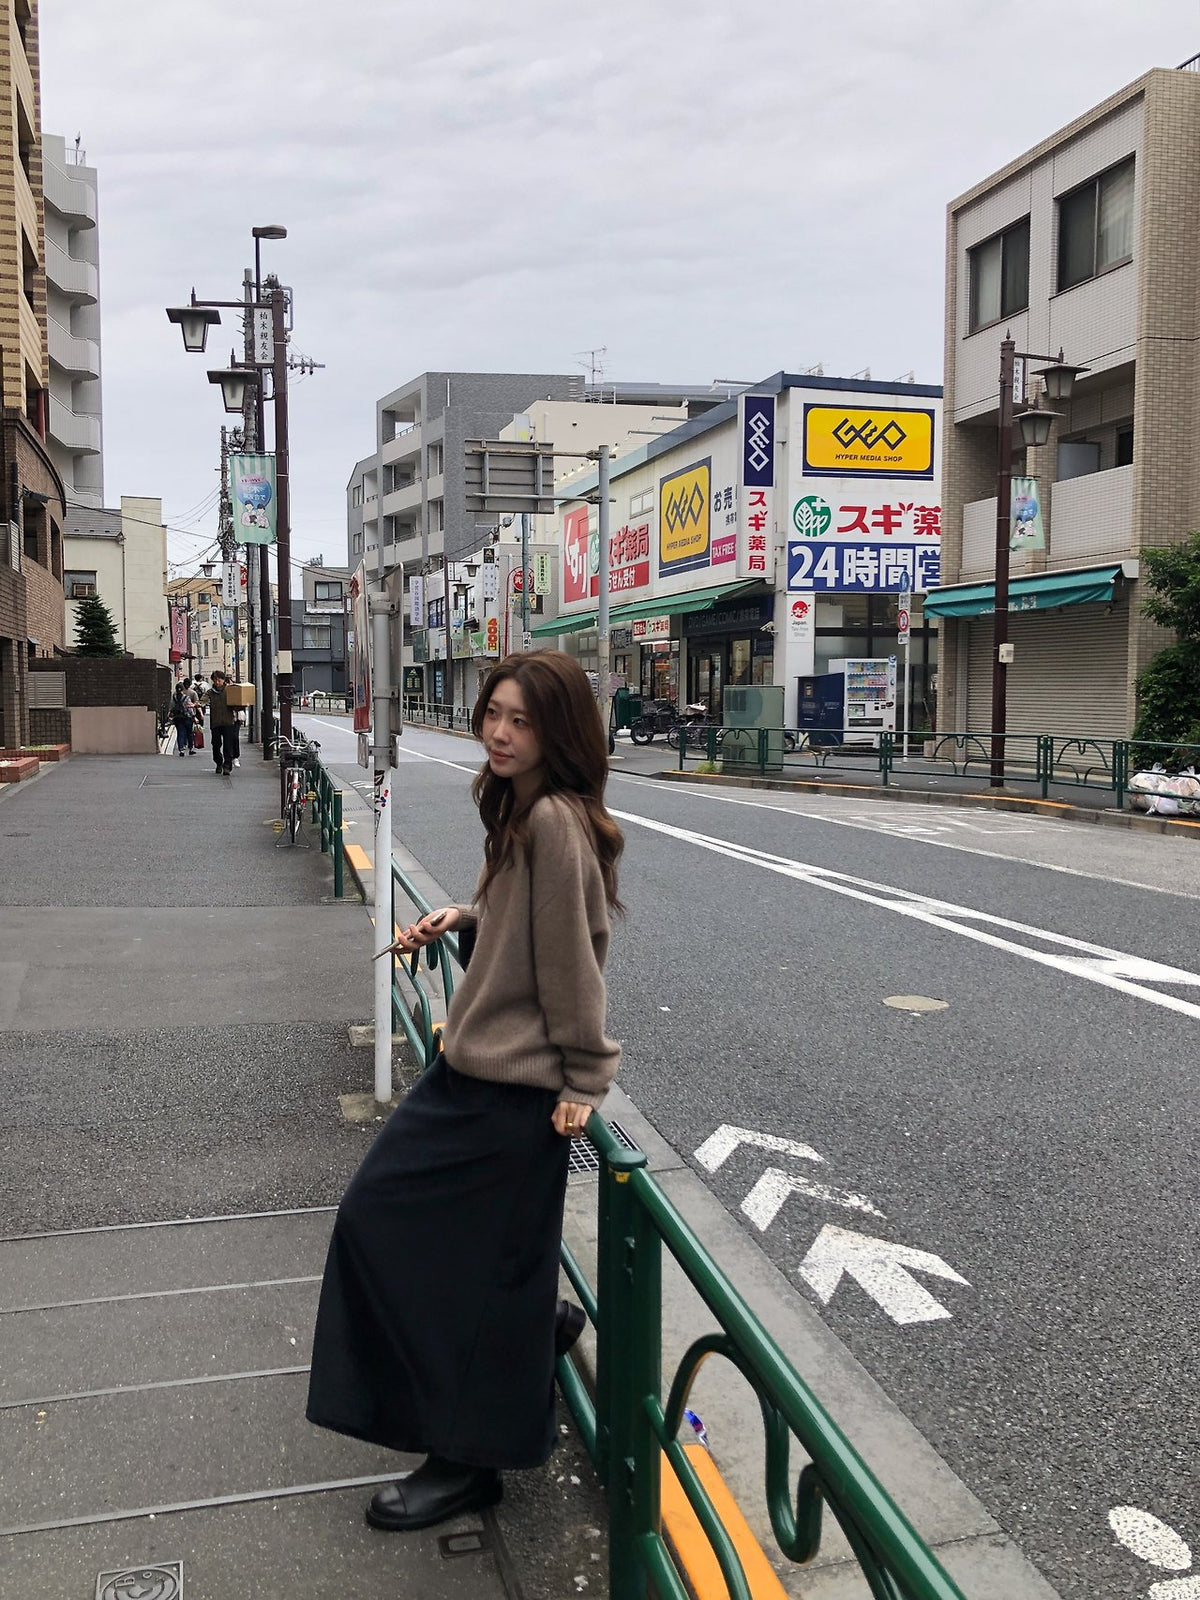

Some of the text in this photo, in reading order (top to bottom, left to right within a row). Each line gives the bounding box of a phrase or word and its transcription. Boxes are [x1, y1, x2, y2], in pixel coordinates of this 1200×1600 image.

[832, 417, 907, 451] GEO
[714, 486, 737, 512] お売
[748, 491, 768, 571] スギ薬局
[565, 518, 587, 593] くすり
[712, 542, 734, 558] TAX FREE
